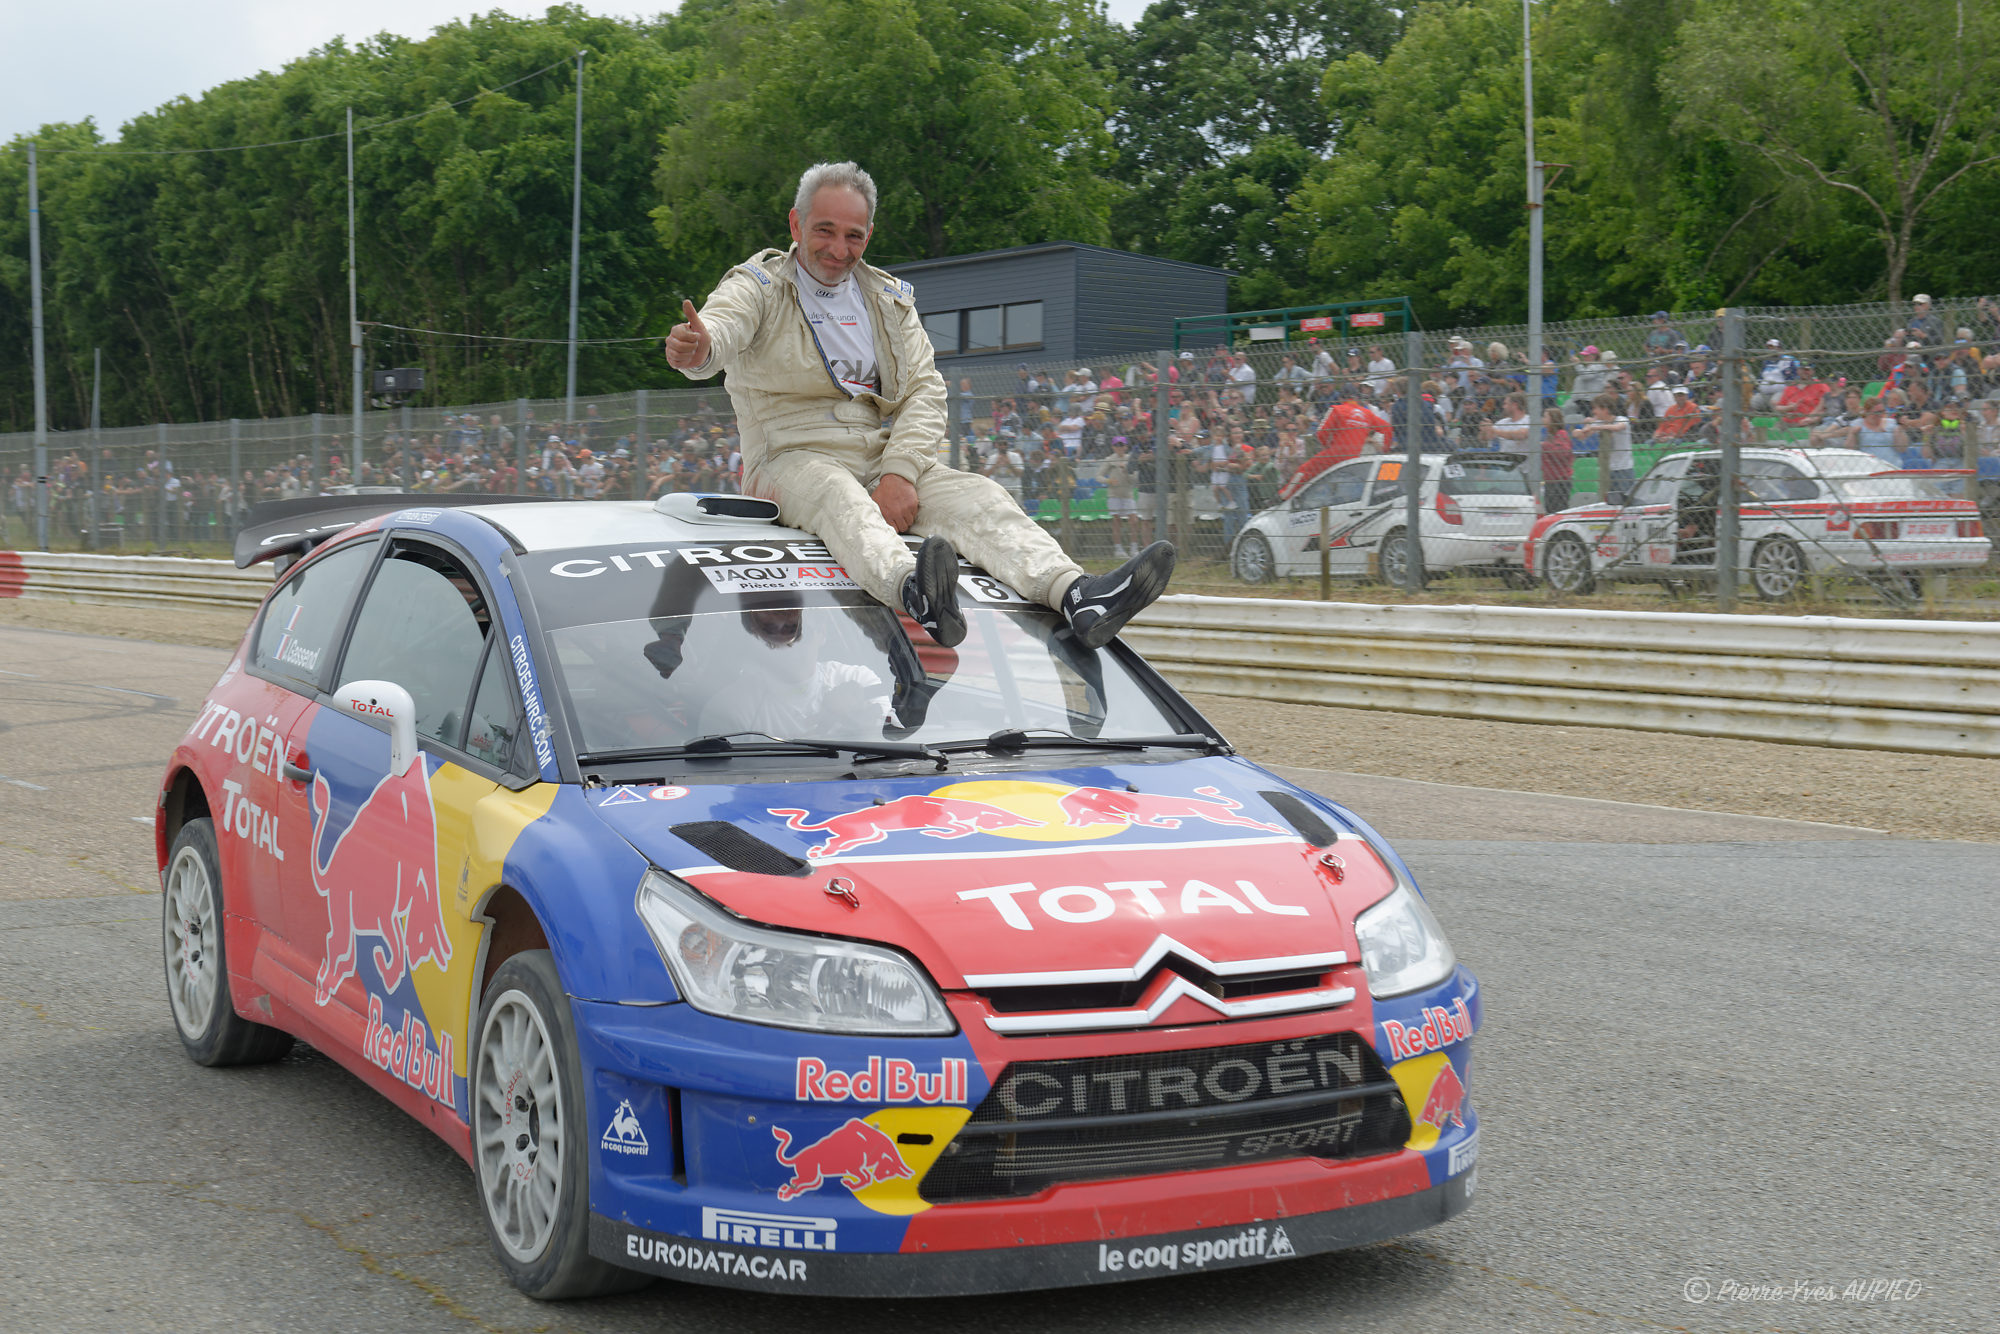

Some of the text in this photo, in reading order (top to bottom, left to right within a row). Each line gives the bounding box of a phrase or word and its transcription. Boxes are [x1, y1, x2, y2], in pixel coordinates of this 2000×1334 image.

[550, 543, 834, 578] CITROË
[798, 567, 850, 579] AUT
[790, 580, 860, 588] d'occasio
[351, 699, 394, 718] TOTAL
[511, 635, 553, 770] CITROEN-WRC.COM
[189, 699, 292, 783] ITROËN
[663, 789, 676, 797] E
[222, 779, 284, 862] TOTAL
[956, 880, 1310, 931] TOTAL
[363, 991, 456, 1109] Red Bull
[1381, 997, 1473, 1061] Red Bull
[795, 1055, 968, 1103] Red Bull
[997, 1042, 1362, 1117] CITROËN
[601, 1140, 649, 1155] le coq sportif
[1236, 1120, 1362, 1157] SPORT
[702, 1206, 838, 1251] PIRELLI
[1098, 1227, 1267, 1272] le coq sportif
[626, 1234, 808, 1282] EURODATACAR
